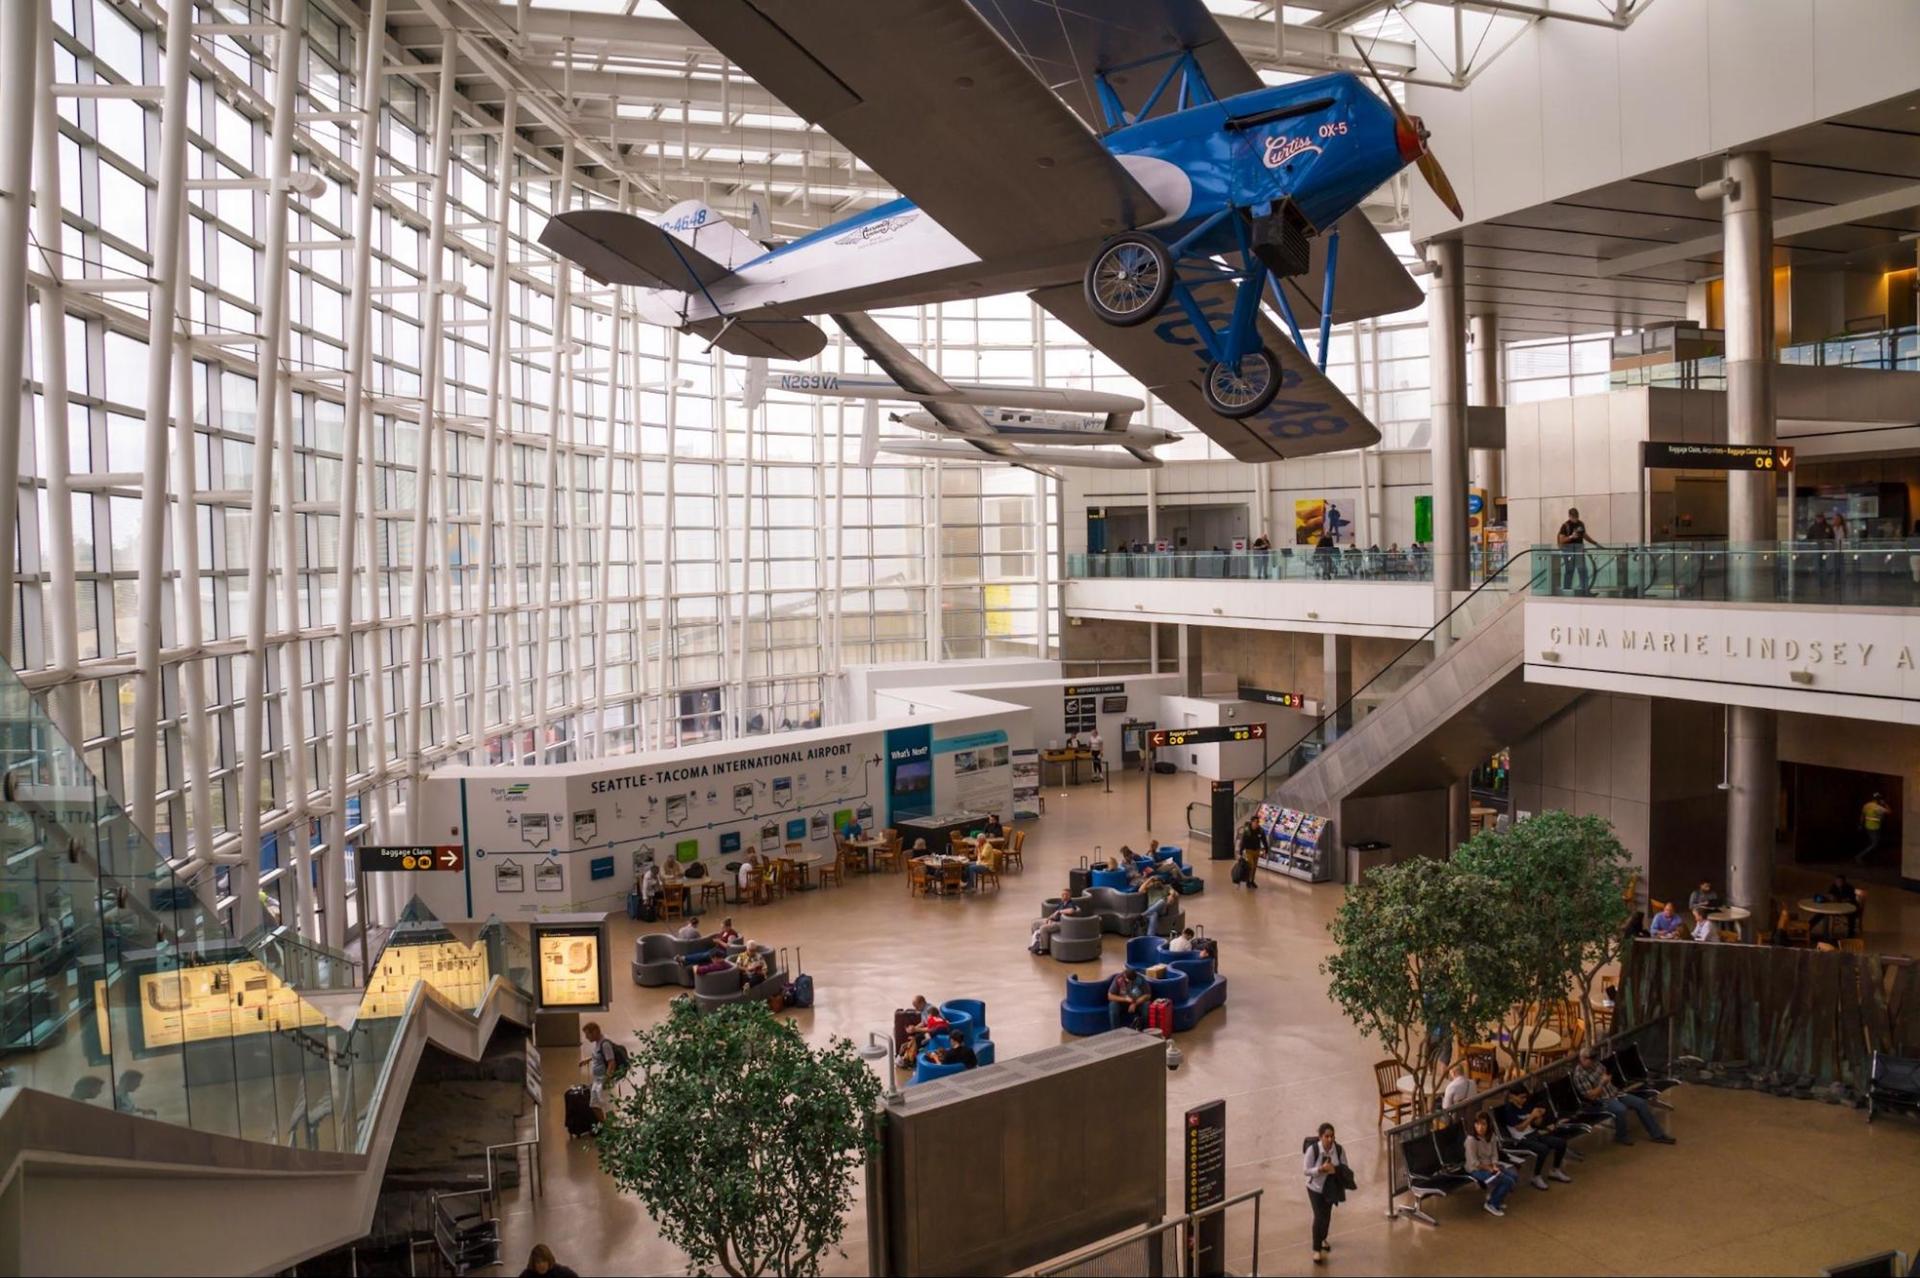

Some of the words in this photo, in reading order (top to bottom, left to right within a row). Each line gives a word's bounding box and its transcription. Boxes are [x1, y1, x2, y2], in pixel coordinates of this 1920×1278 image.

[1319, 122, 1348, 138] OX-5
[1263, 136, 1323, 169] Curtiss
[660, 209, 707, 232] C-4648
[781, 375, 839, 390] N269VA
[1550, 626, 1608, 648] GINA
[1622, 630, 1708, 655] MARIE
[1726, 636, 1874, 667] LINDSEY
[1897, 646, 1915, 670] A
[891, 747, 911, 760] What's
[911, 746, 928, 756] Next?
[591, 765, 709, 794] SEATTLE-TACOMA
[713, 752, 804, 775] INTERNATIONAL
[807, 743, 852, 760] AIRPORT
[381, 849, 411, 857] Baggage
[412, 848, 432, 856] Claim
